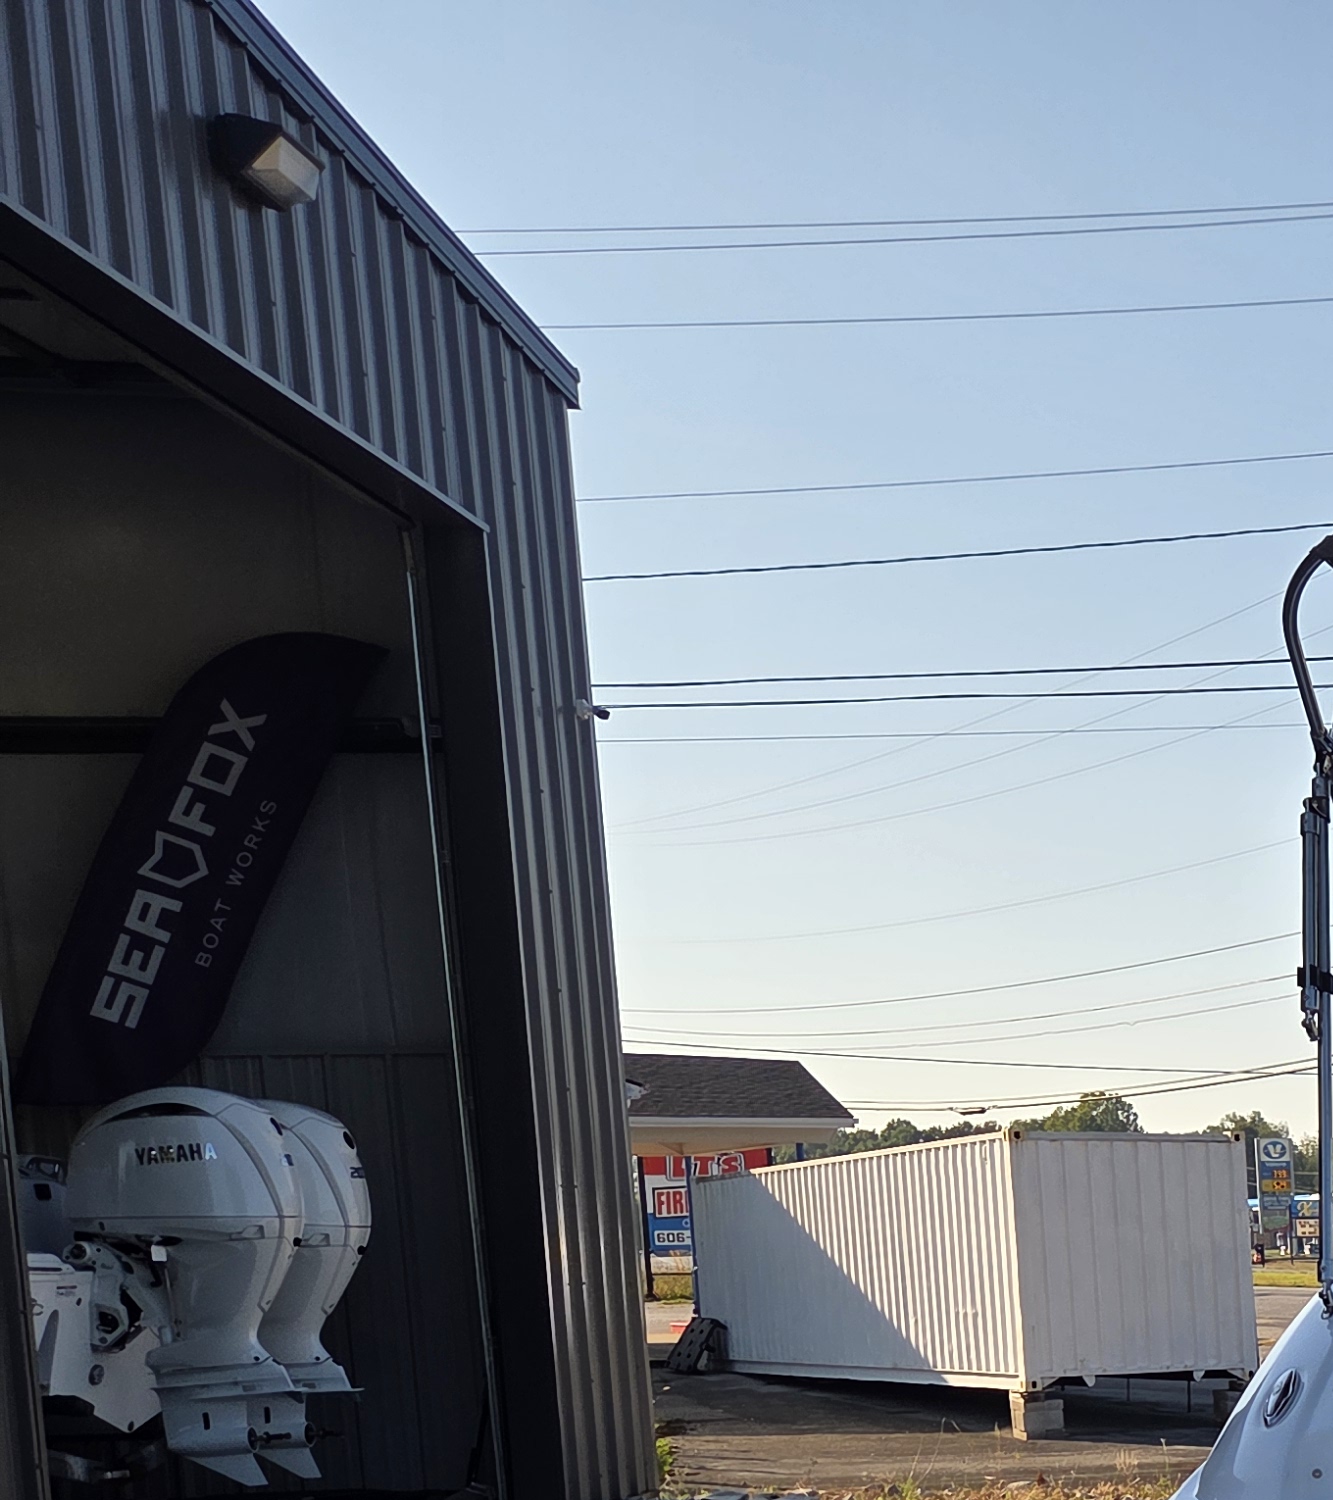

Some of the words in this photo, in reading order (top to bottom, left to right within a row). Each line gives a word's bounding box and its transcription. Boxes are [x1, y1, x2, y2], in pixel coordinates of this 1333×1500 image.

[90, 888, 183, 1029] SEA
[168, 697, 268, 837] FOX
[195, 897, 232, 968] BOAT
[225, 800, 277, 887] WORKS
[135, 1143, 218, 1166] YAMAHA
[656, 1190, 690, 1215] FIR
